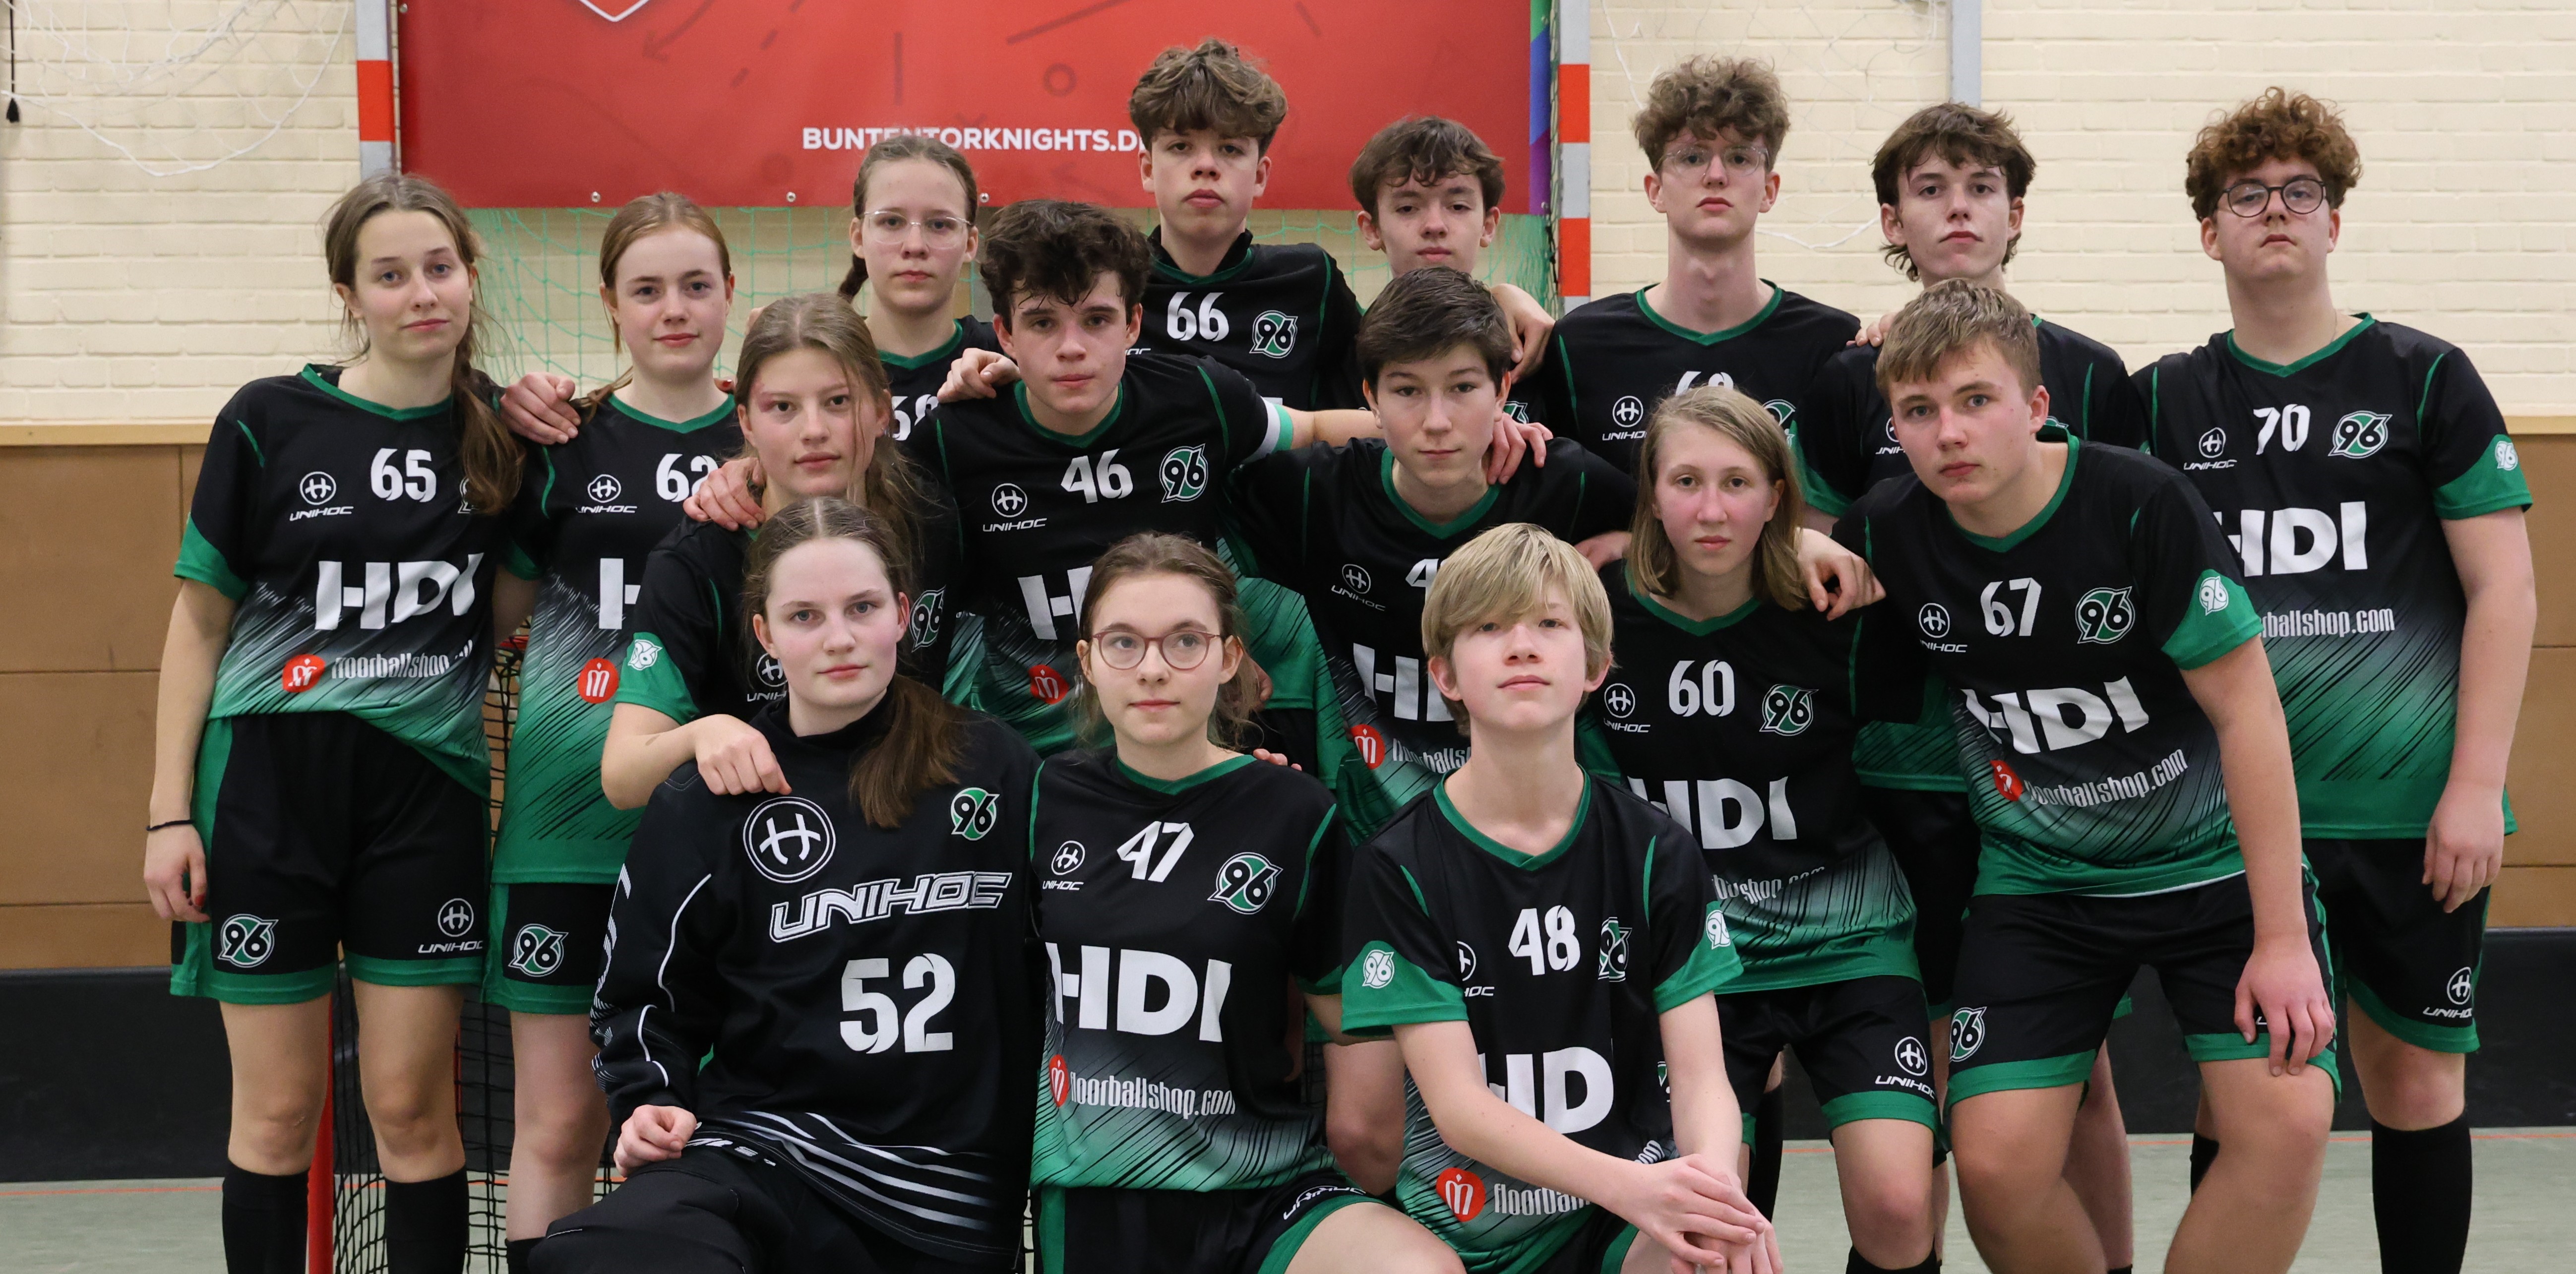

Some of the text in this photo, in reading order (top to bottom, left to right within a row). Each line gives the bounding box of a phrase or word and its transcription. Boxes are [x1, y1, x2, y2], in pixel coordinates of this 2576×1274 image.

[1167, 292, 1229, 341] 66
[1249, 310, 1298, 359] 96
[1602, 430, 1647, 441] UNIHO
[2253, 404, 2311, 455] 70
[2328, 411, 2392, 459] 96
[370, 448, 437, 502] 65
[1060, 448, 1133, 503] 46
[1159, 443, 1208, 502] 96
[2183, 459, 2237, 470] UNIHOC
[290, 506, 354, 521] UNIHOC
[575, 505, 637, 514] UNIHOC
[982, 518, 1047, 532] UNIHOC
[314, 552, 484, 630] HDI
[1331, 585, 1386, 611] UNIHOC
[1980, 577, 2042, 637] 67
[2076, 586, 2135, 644] 96
[2199, 575, 2229, 615] 96
[1668, 660, 1735, 717] 60
[1759, 684, 1819, 736] 96
[1603, 719, 1651, 733] UNIHOC
[1961, 676, 2149, 755] HDI
[951, 788, 1000, 841] 96
[1117, 820, 1194, 883] 47
[769, 871, 1013, 943] UNIHOC
[1042, 880, 1084, 891] UNIHOC
[1207, 851, 1284, 915] 96
[217, 913, 279, 968] 96
[508, 923, 569, 977] 96
[1508, 905, 1581, 976] 48
[1045, 942, 1232, 1042] HDI
[1362, 949, 1395, 989] 96
[840, 953, 956, 1054] 52
[2423, 1007, 2472, 1018] UNIHO
